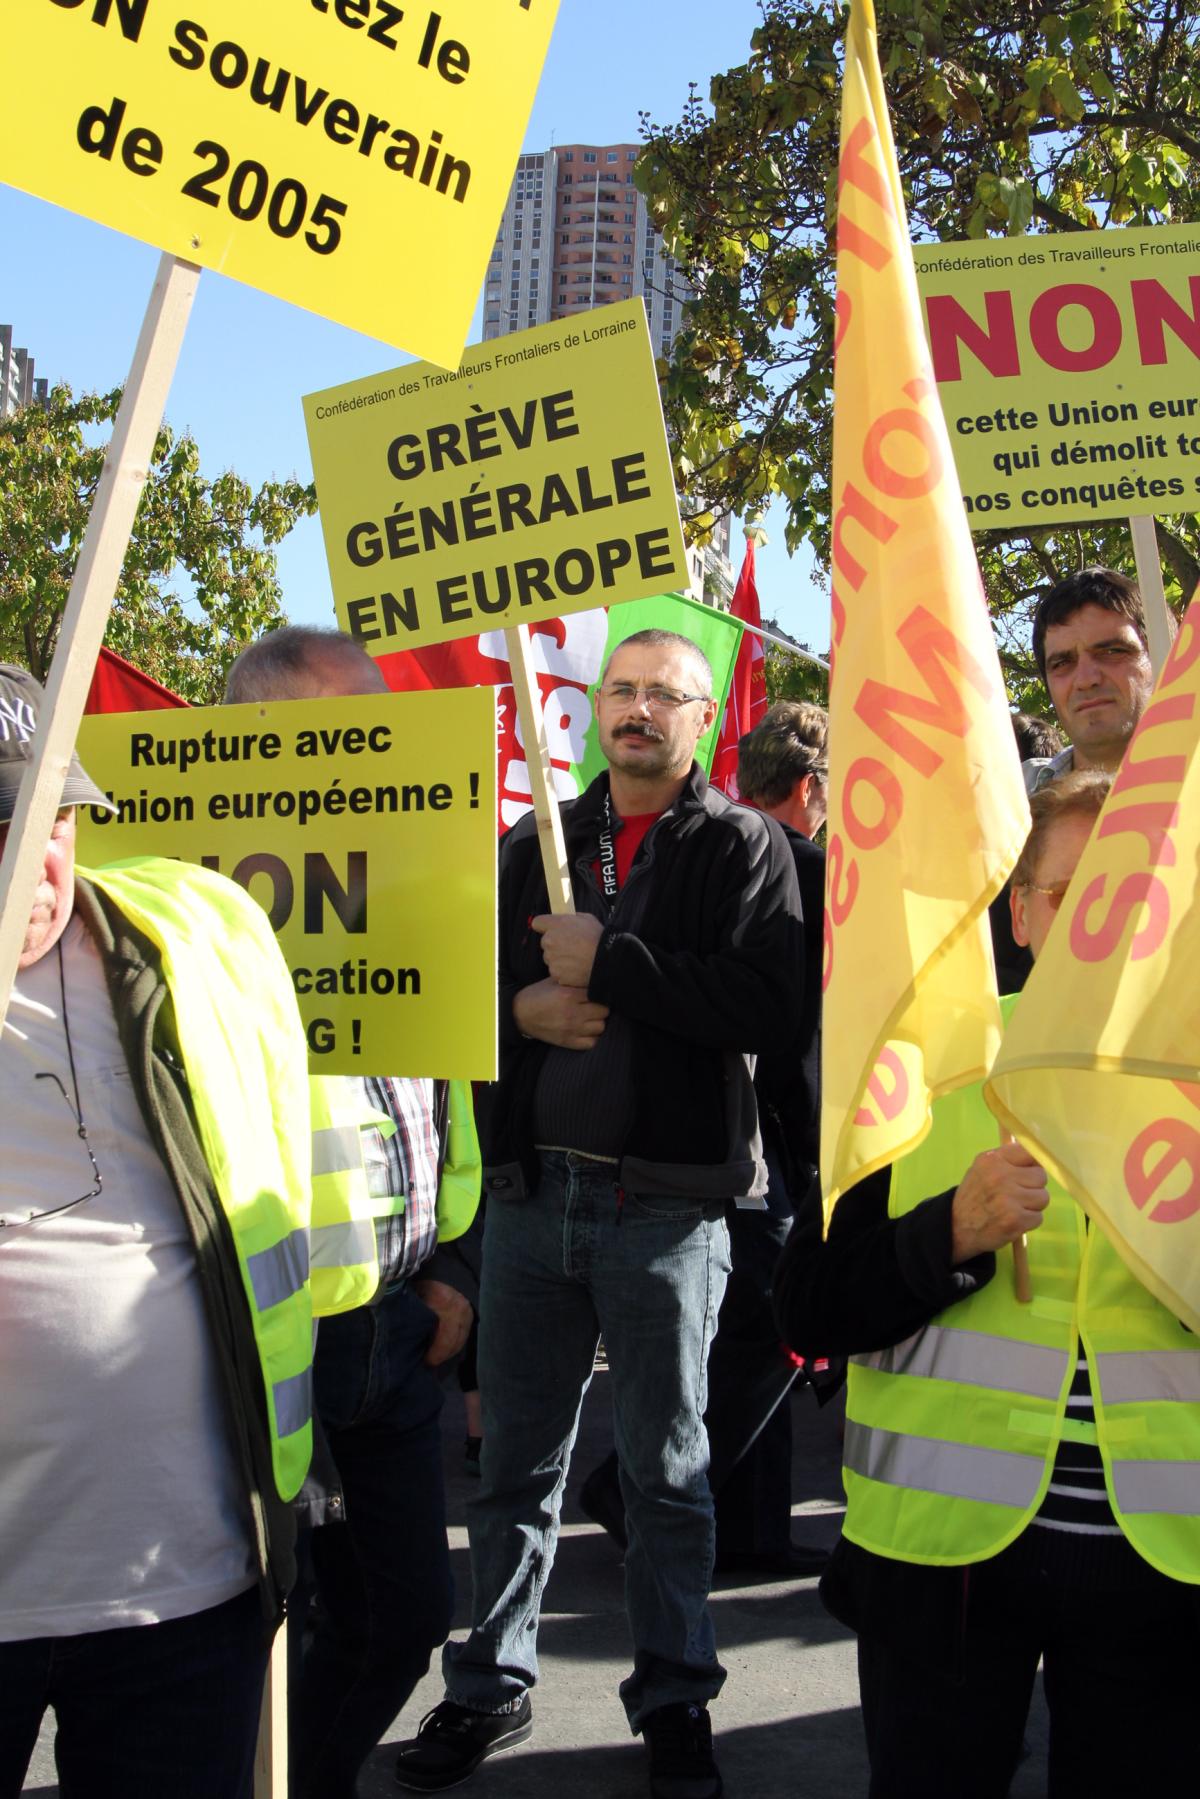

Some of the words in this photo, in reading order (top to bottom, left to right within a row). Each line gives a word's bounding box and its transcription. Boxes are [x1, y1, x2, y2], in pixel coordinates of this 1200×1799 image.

[418, 11, 470, 84] le
[168, 19, 472, 203] souverain
[76, 97, 163, 177] de
[181, 140, 348, 255] 2005
[1018, 252, 1045, 266] des
[1049, 245, 1136, 263] Travailleurs
[316, 387, 396, 420] Confédération
[399, 382, 420, 396] des
[422, 361, 492, 389] Travailleurs
[495, 340, 561, 368] Frontaliers
[564, 334, 580, 348] de
[583, 319, 637, 343] Lorraine
[387, 389, 580, 481] GRÈVE
[956, 408, 1038, 435] cette
[1048, 400, 1138, 427] Union
[1148, 398, 1200, 418] eur
[993, 444, 1040, 476] qui
[1051, 434, 1168, 466] démolit
[346, 452, 651, 567] GÉNÉRALE
[1021, 475, 1184, 508] conquêtes
[346, 587, 420, 643] EN
[436, 528, 675, 624] EUROPE
[130, 729, 281, 773] Rupture
[295, 724, 392, 757] avec
[208, 779, 452, 825] européenne
[468, 773, 481, 809] !
[167, 851, 367, 934] ON
[602, 864, 616, 895] FIFA
[291, 959, 421, 995] cation
[308, 1018, 336, 1055] G
